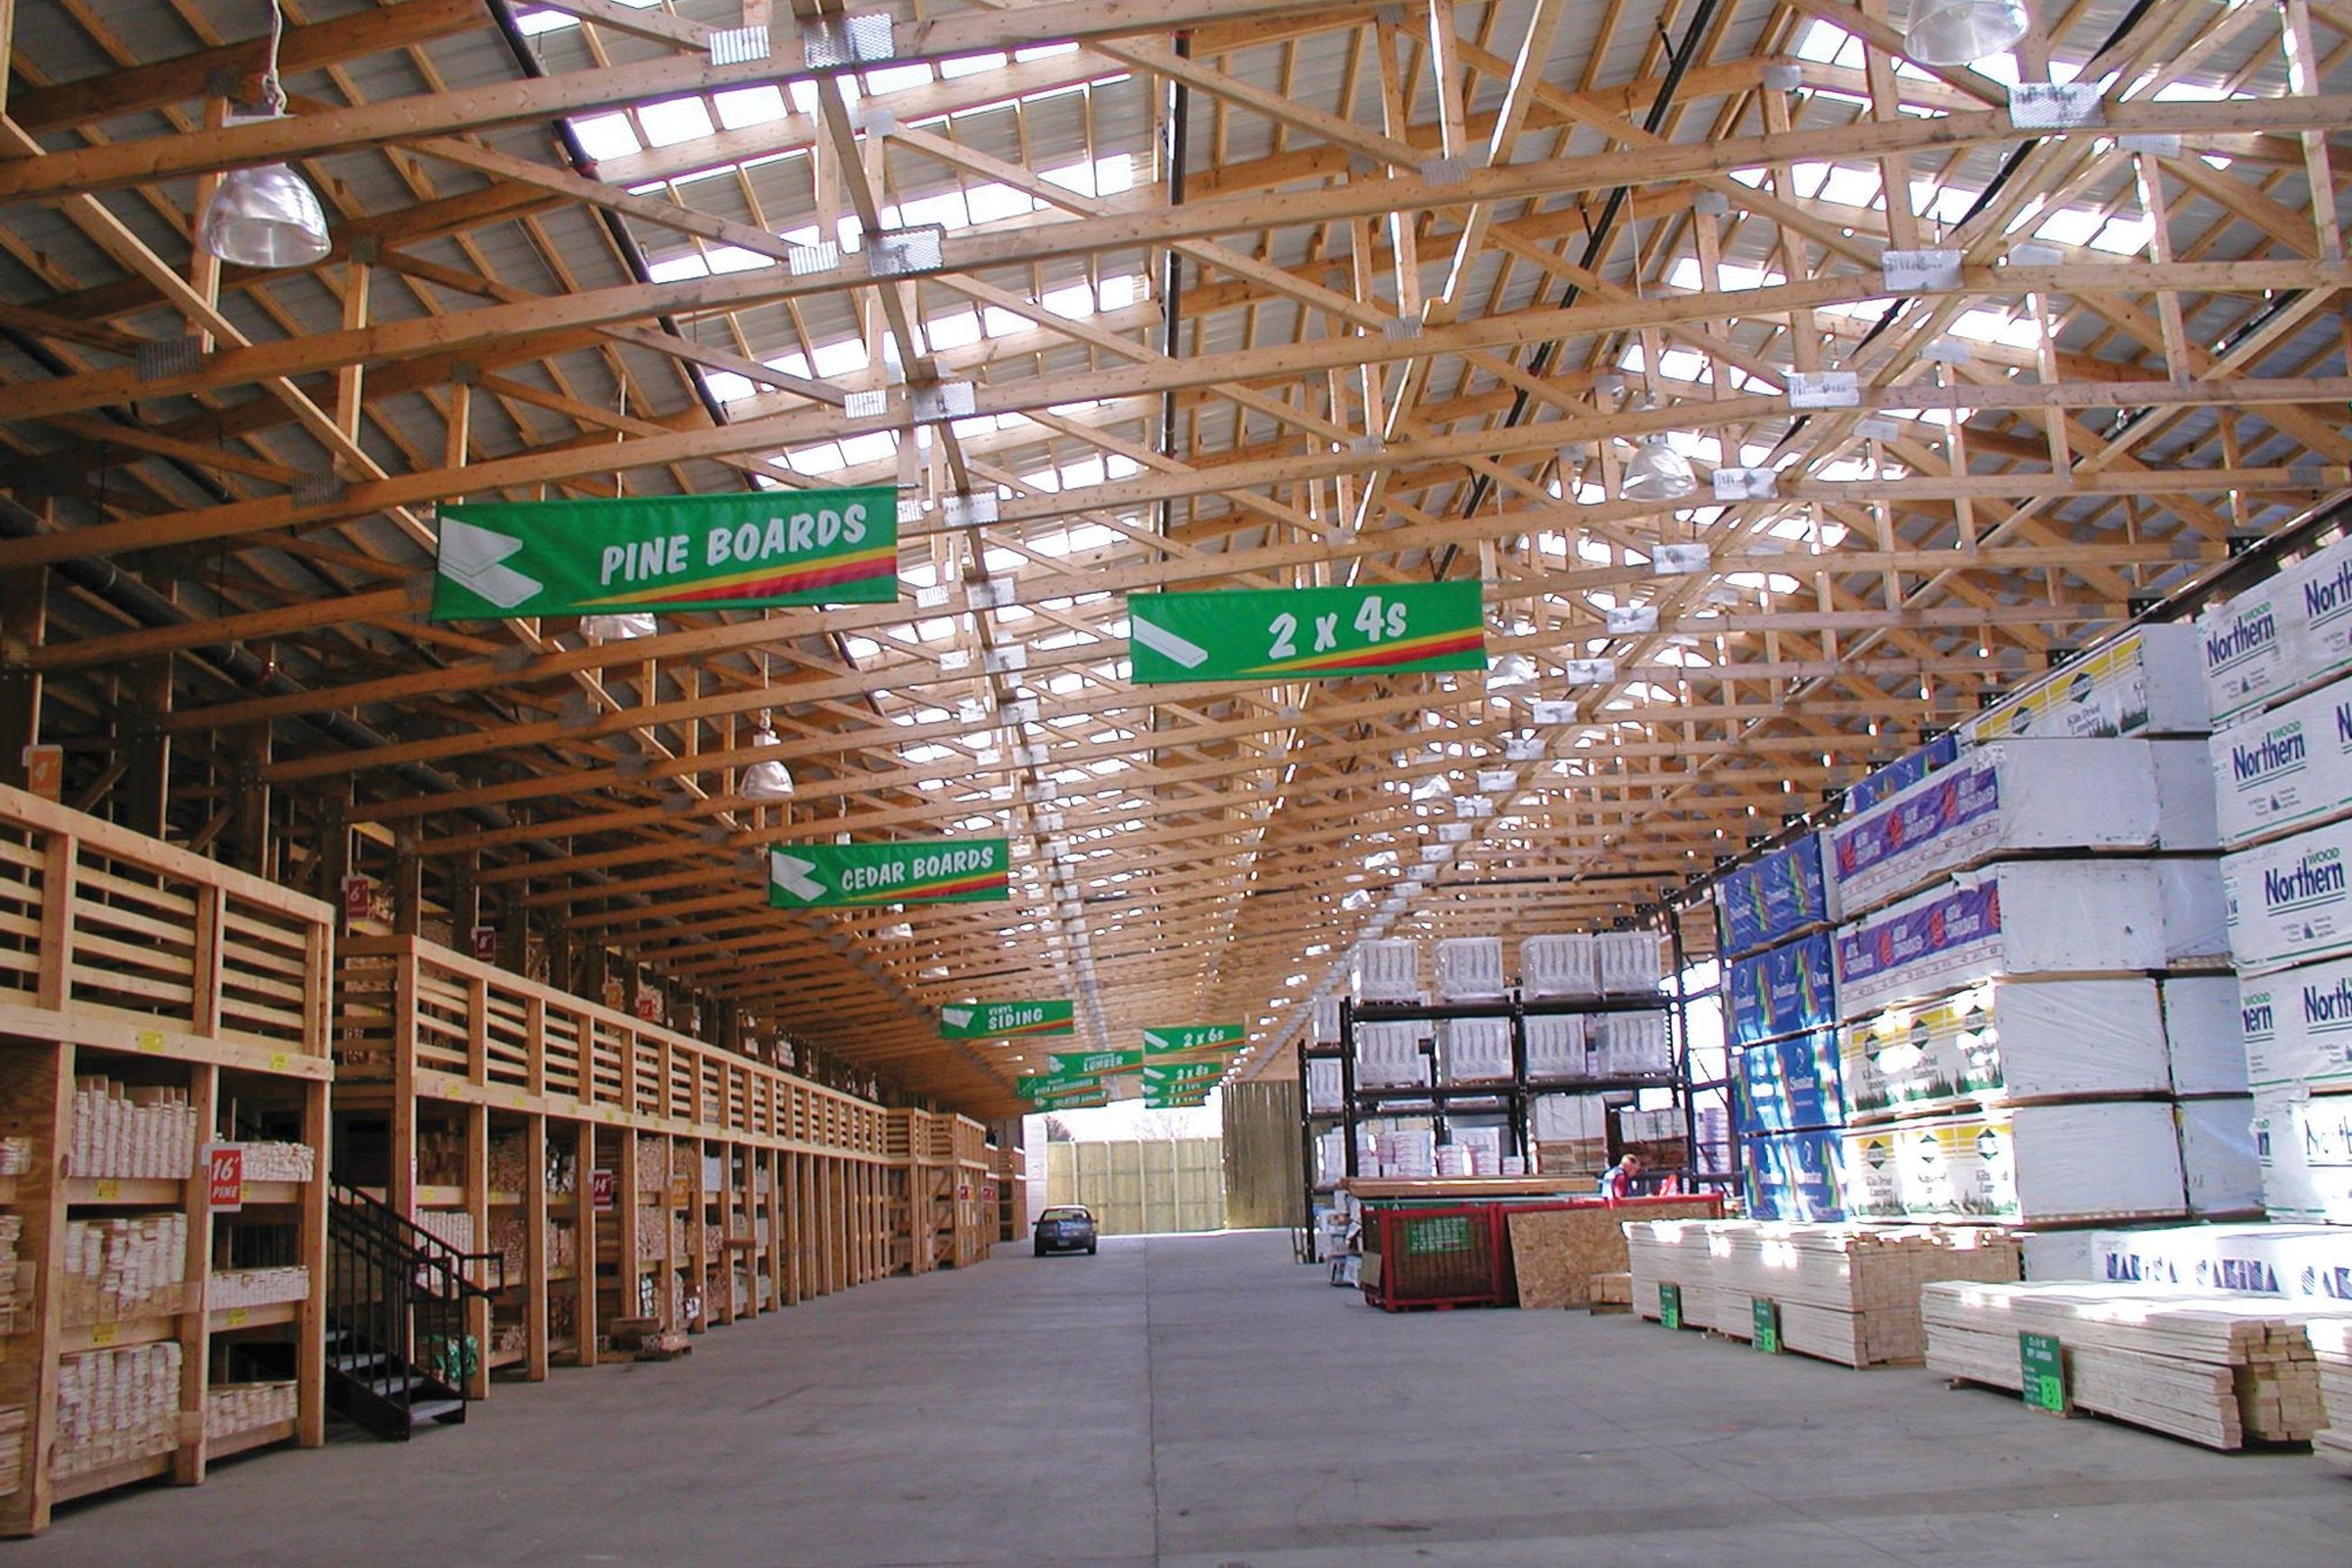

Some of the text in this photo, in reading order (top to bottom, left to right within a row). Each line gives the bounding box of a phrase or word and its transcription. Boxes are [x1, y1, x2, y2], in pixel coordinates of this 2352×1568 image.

[600, 503, 867, 586] PINE BOARDS
[1268, 612, 1298, 659] 2
[1354, 596, 1407, 643] 4s
[2206, 615, 2275, 668] Northern
[2233, 733, 2305, 781] Northern
[842, 846, 994, 890] CEDAR BOARDS
[2308, 847, 2340, 864] WOOD
[2265, 857, 2345, 906] Northern
[988, 1007, 1044, 1030] SIDING
[1183, 1033, 1193, 1047] 2
[1208, 1028, 1225, 1043] 6s
[1083, 1055, 1124, 1072] LUMBER
[212, 1185, 238, 1199] PINE
